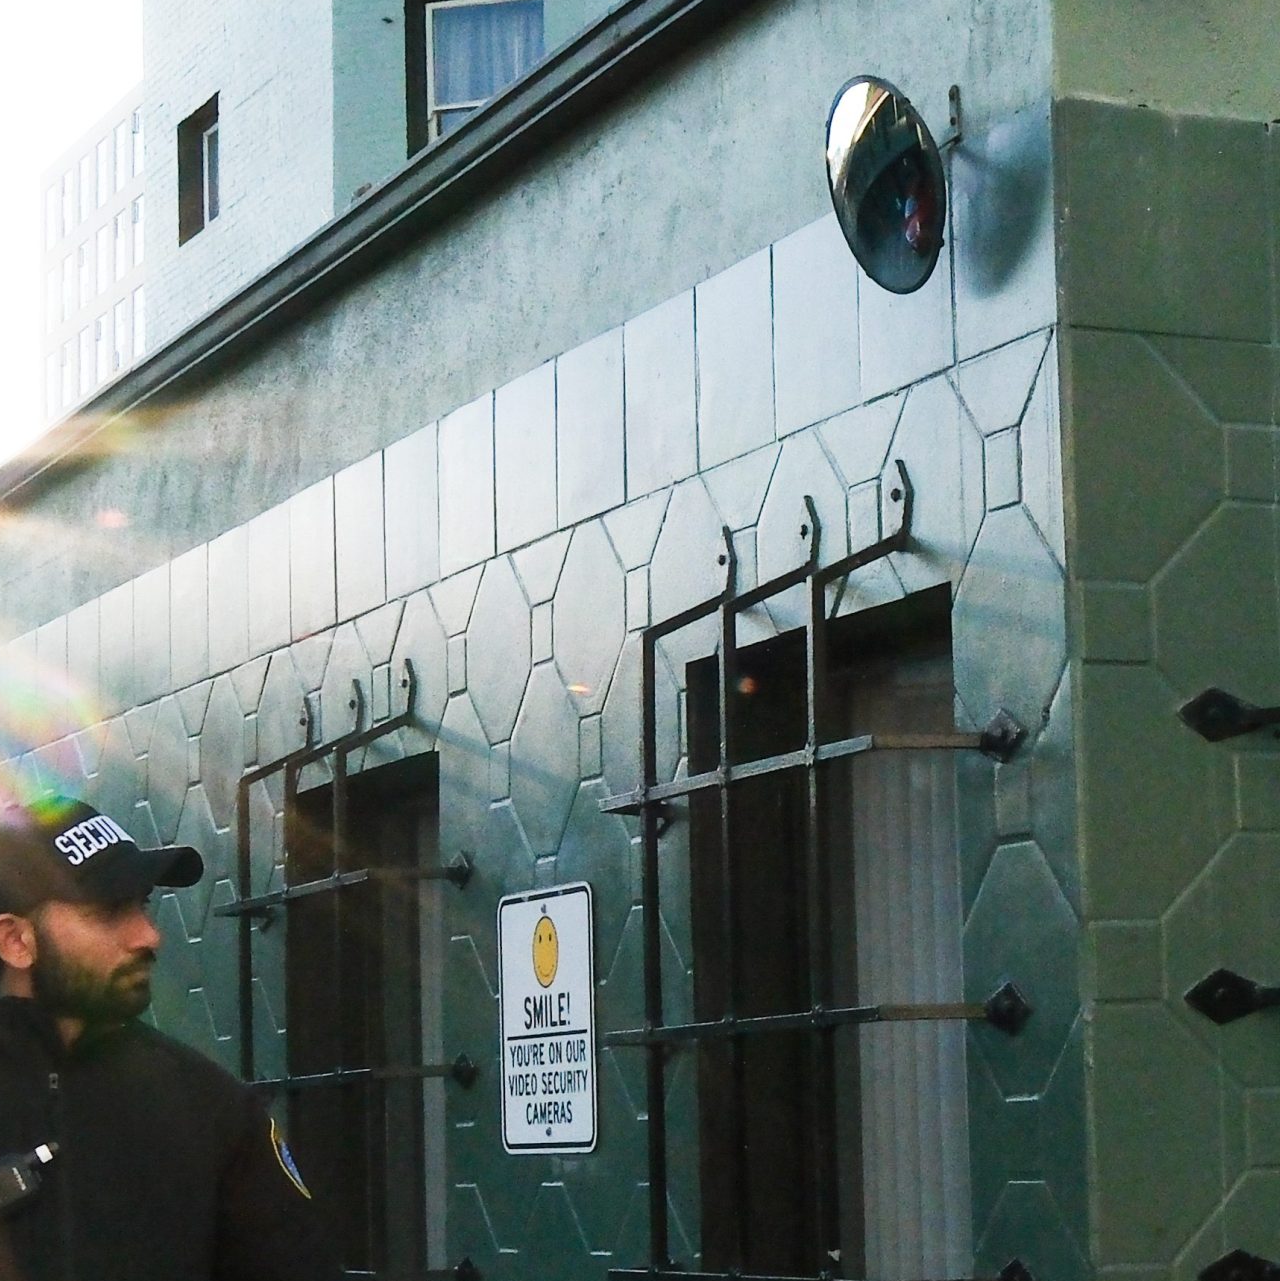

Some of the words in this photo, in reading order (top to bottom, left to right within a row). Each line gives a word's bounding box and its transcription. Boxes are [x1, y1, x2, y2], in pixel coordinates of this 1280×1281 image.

[524, 992, 570, 1029] SMILE!
[509, 1043, 545, 1068] YOU'RE
[548, 1042, 562, 1064] ON
[565, 1039, 586, 1063] OUR
[508, 1073, 538, 1097] VIDEO
[541, 1068, 589, 1095] SECURITY
[526, 1100, 572, 1125] CAMERAS
